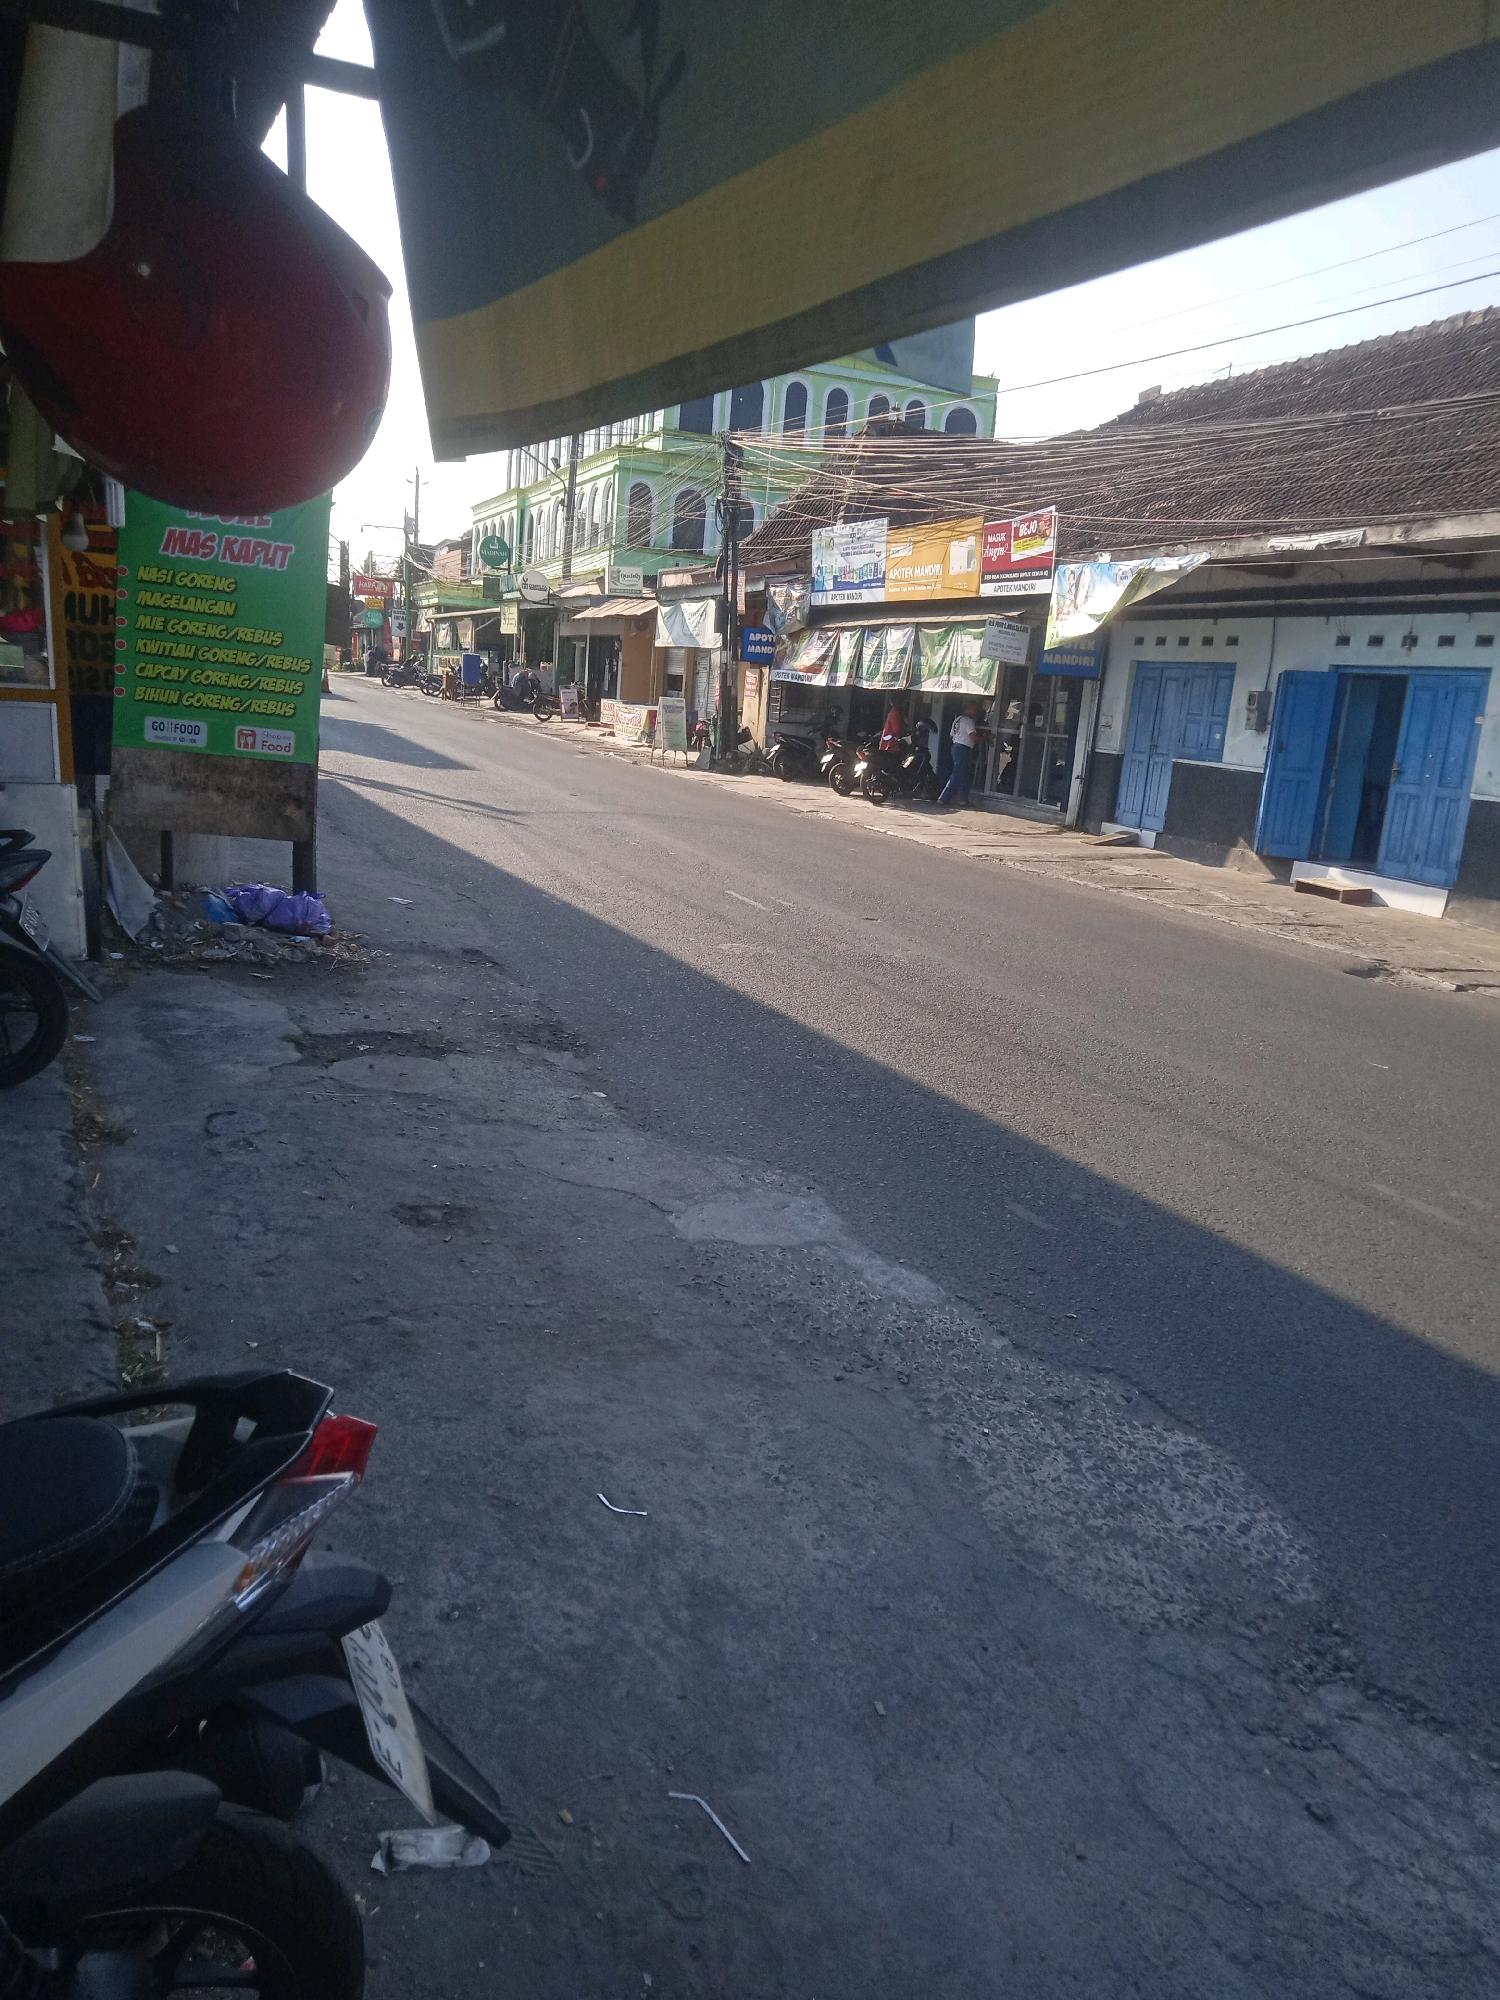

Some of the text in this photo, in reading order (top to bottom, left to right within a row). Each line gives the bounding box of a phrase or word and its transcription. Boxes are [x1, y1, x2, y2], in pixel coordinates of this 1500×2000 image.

[1019, 520, 1038, 537] BEJO
[988, 532, 1007, 543] MASUK
[159, 527, 295, 571] MAS KAPUT
[136, 565, 175, 585] NASI
[175, 571, 238, 593] GORENG
[889, 563, 943, 579] APOTEK MANDIRI
[993, 583, 1037, 593] APOTEK MANDIRI
[135, 590, 238, 618] MAGELANGAN
[135, 614, 284, 646] MIE GORENG/REBUS
[749, 632, 777, 642] APOT
[135, 638, 197, 660] KWITIAU
[198, 646, 313, 673] GORENG/REBUS
[747, 645, 776, 654] MAND
[1042, 652, 1096, 667] MANDIRI
[134, 662, 190, 682] CAPCAY
[190, 669, 305, 695] GORENG/REBUS
[133, 686, 297, 717] BIHUN GORENG/REBUS
[262, 730, 292, 741] Shopee
[261, 740, 292, 753] Food
